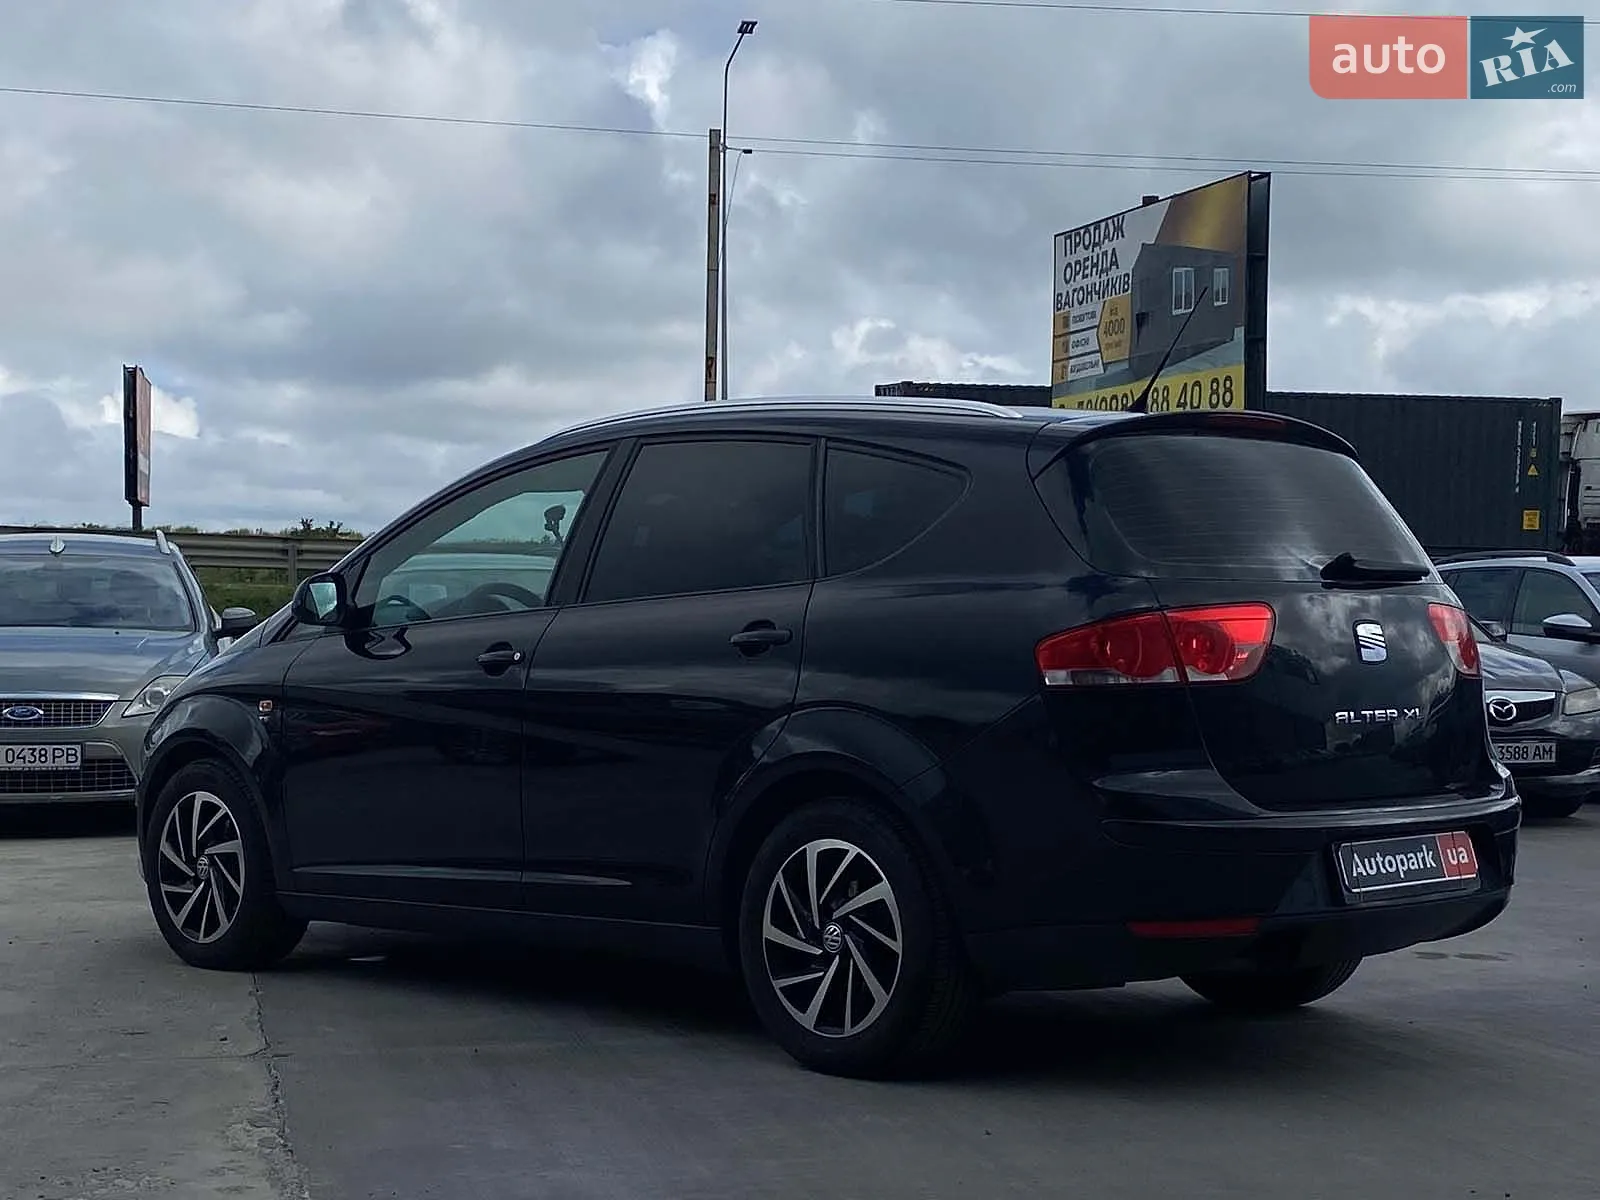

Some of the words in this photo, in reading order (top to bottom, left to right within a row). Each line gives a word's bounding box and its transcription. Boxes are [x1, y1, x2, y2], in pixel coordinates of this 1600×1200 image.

[1063, 215, 1126, 257] ПРОДАЖ
[1063, 248, 1120, 285] ОРЕНДА
[1056, 272, 1131, 312] ВАГОНЧИКІВ
[1176, 380, 1202, 410] 40
[1208, 375, 1234, 409] 88
[5, 747, 48, 764] 0438
[52, 748, 79, 764] PB
[1497, 745, 1529, 761] 3588
[1532, 745, 1554, 761] AM
[1352, 844, 1437, 879] Autopark
[1446, 846, 1469, 865] ua
